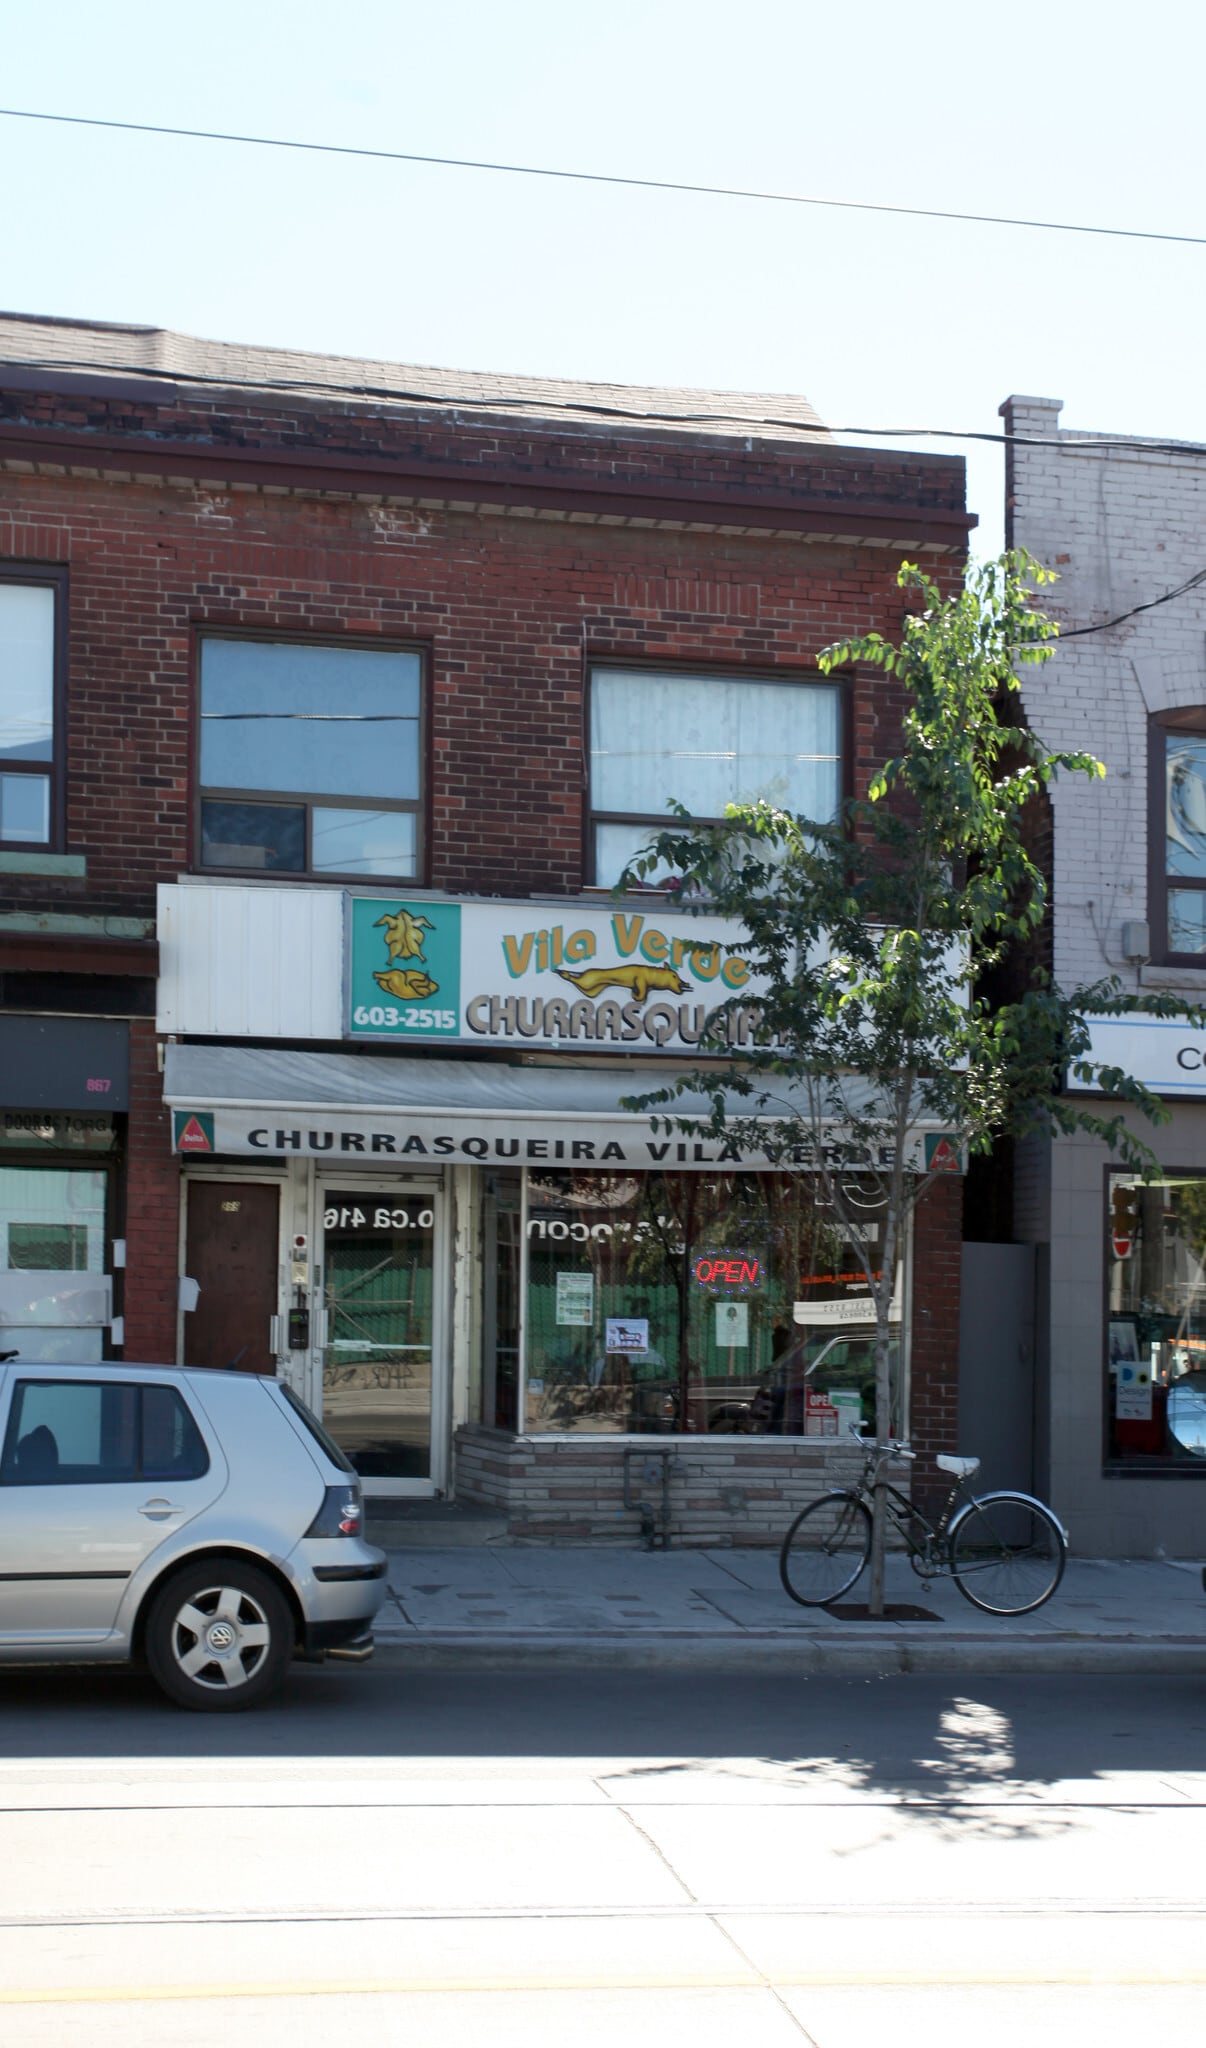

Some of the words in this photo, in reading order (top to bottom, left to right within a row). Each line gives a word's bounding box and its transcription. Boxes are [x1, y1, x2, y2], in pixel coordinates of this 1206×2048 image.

[502, 925, 596, 979] Vila
[611, 914, 750, 990] Verde
[353, 1006, 457, 1030] 603-2515
[466, 995, 790, 1047] CHURRASQUEIR
[1177, 1047, 1206, 1071] C
[86, 1078, 111, 1093] 867
[247, 1128, 627, 1161] CHURRASQUEIRA
[645, 1142, 743, 1163] VILA
[696, 1259, 759, 1283] OPEN
[810, 1393, 831, 1407] OPE
